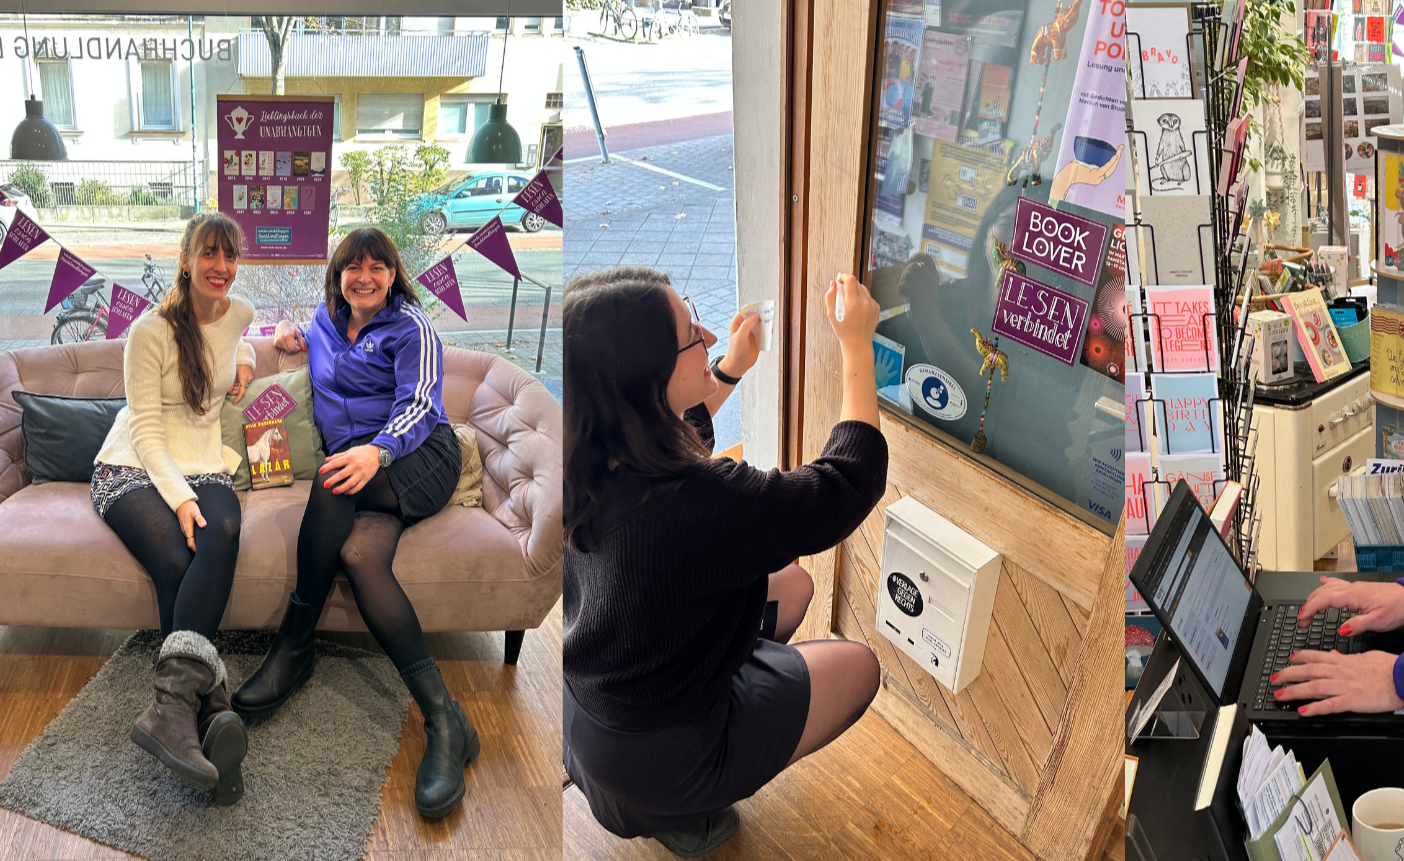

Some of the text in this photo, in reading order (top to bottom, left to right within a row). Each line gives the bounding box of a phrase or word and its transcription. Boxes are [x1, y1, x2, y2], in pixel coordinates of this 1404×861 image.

[1141, 47, 1178, 64] BRAVO
[1087, 61, 1113, 73] Lesung
[1090, 93, 1118, 104] Gedichten
[1099, 101, 1110, 109] von
[260, 110, 323, 123] Lieblingsbuch der
[520, 178, 545, 203] LESEN
[17, 216, 42, 240] LESEN
[1029, 211, 1090, 250] BOOK
[1023, 232, 1087, 273] LOVER
[425, 262, 448, 283] LESEN
[117, 289, 142, 307] LESEN
[1004, 276, 1080, 330] LESEN
[1175, 301, 1209, 314] TAKES
[1002, 309, 1073, 350] verbindet
[1175, 327, 1211, 339] BECOME
[1165, 340, 1212, 352] LEGEND
[1387, 348, 1397, 362] Die
[247, 385, 283, 421] LESEN
[1162, 397, 1209, 409] HAPPY
[251, 459, 290, 475] LAZÁR
[1165, 471, 1218, 482] GÄNSE
[1088, 499, 1112, 520] VISA
[896, 576, 919, 598] VERLAGE
[897, 587, 916, 605] GEGEN
